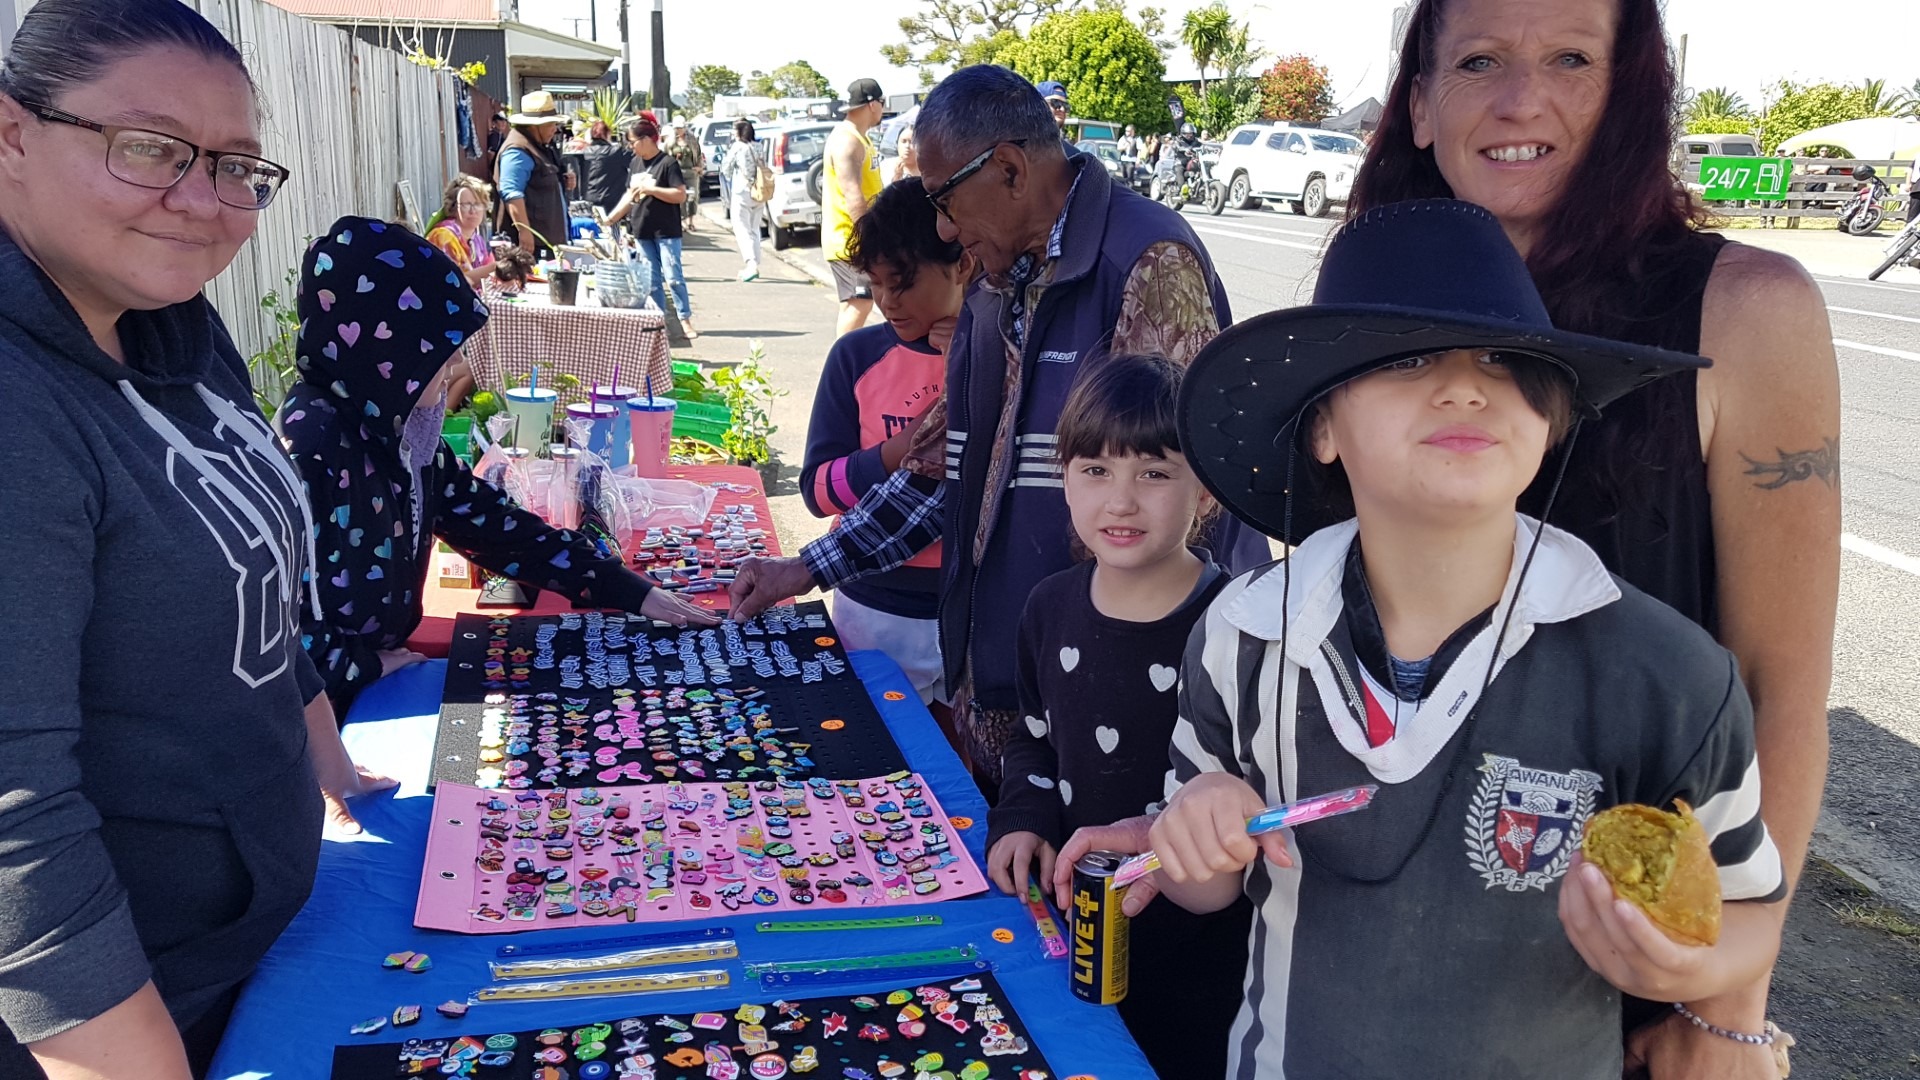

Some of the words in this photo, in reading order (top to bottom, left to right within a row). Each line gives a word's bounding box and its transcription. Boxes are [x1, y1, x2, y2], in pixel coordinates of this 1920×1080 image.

[1705, 167, 1751, 189] 24/7
[1508, 769, 1578, 791] AWANUI
[1075, 919, 1093, 984] LIVE
